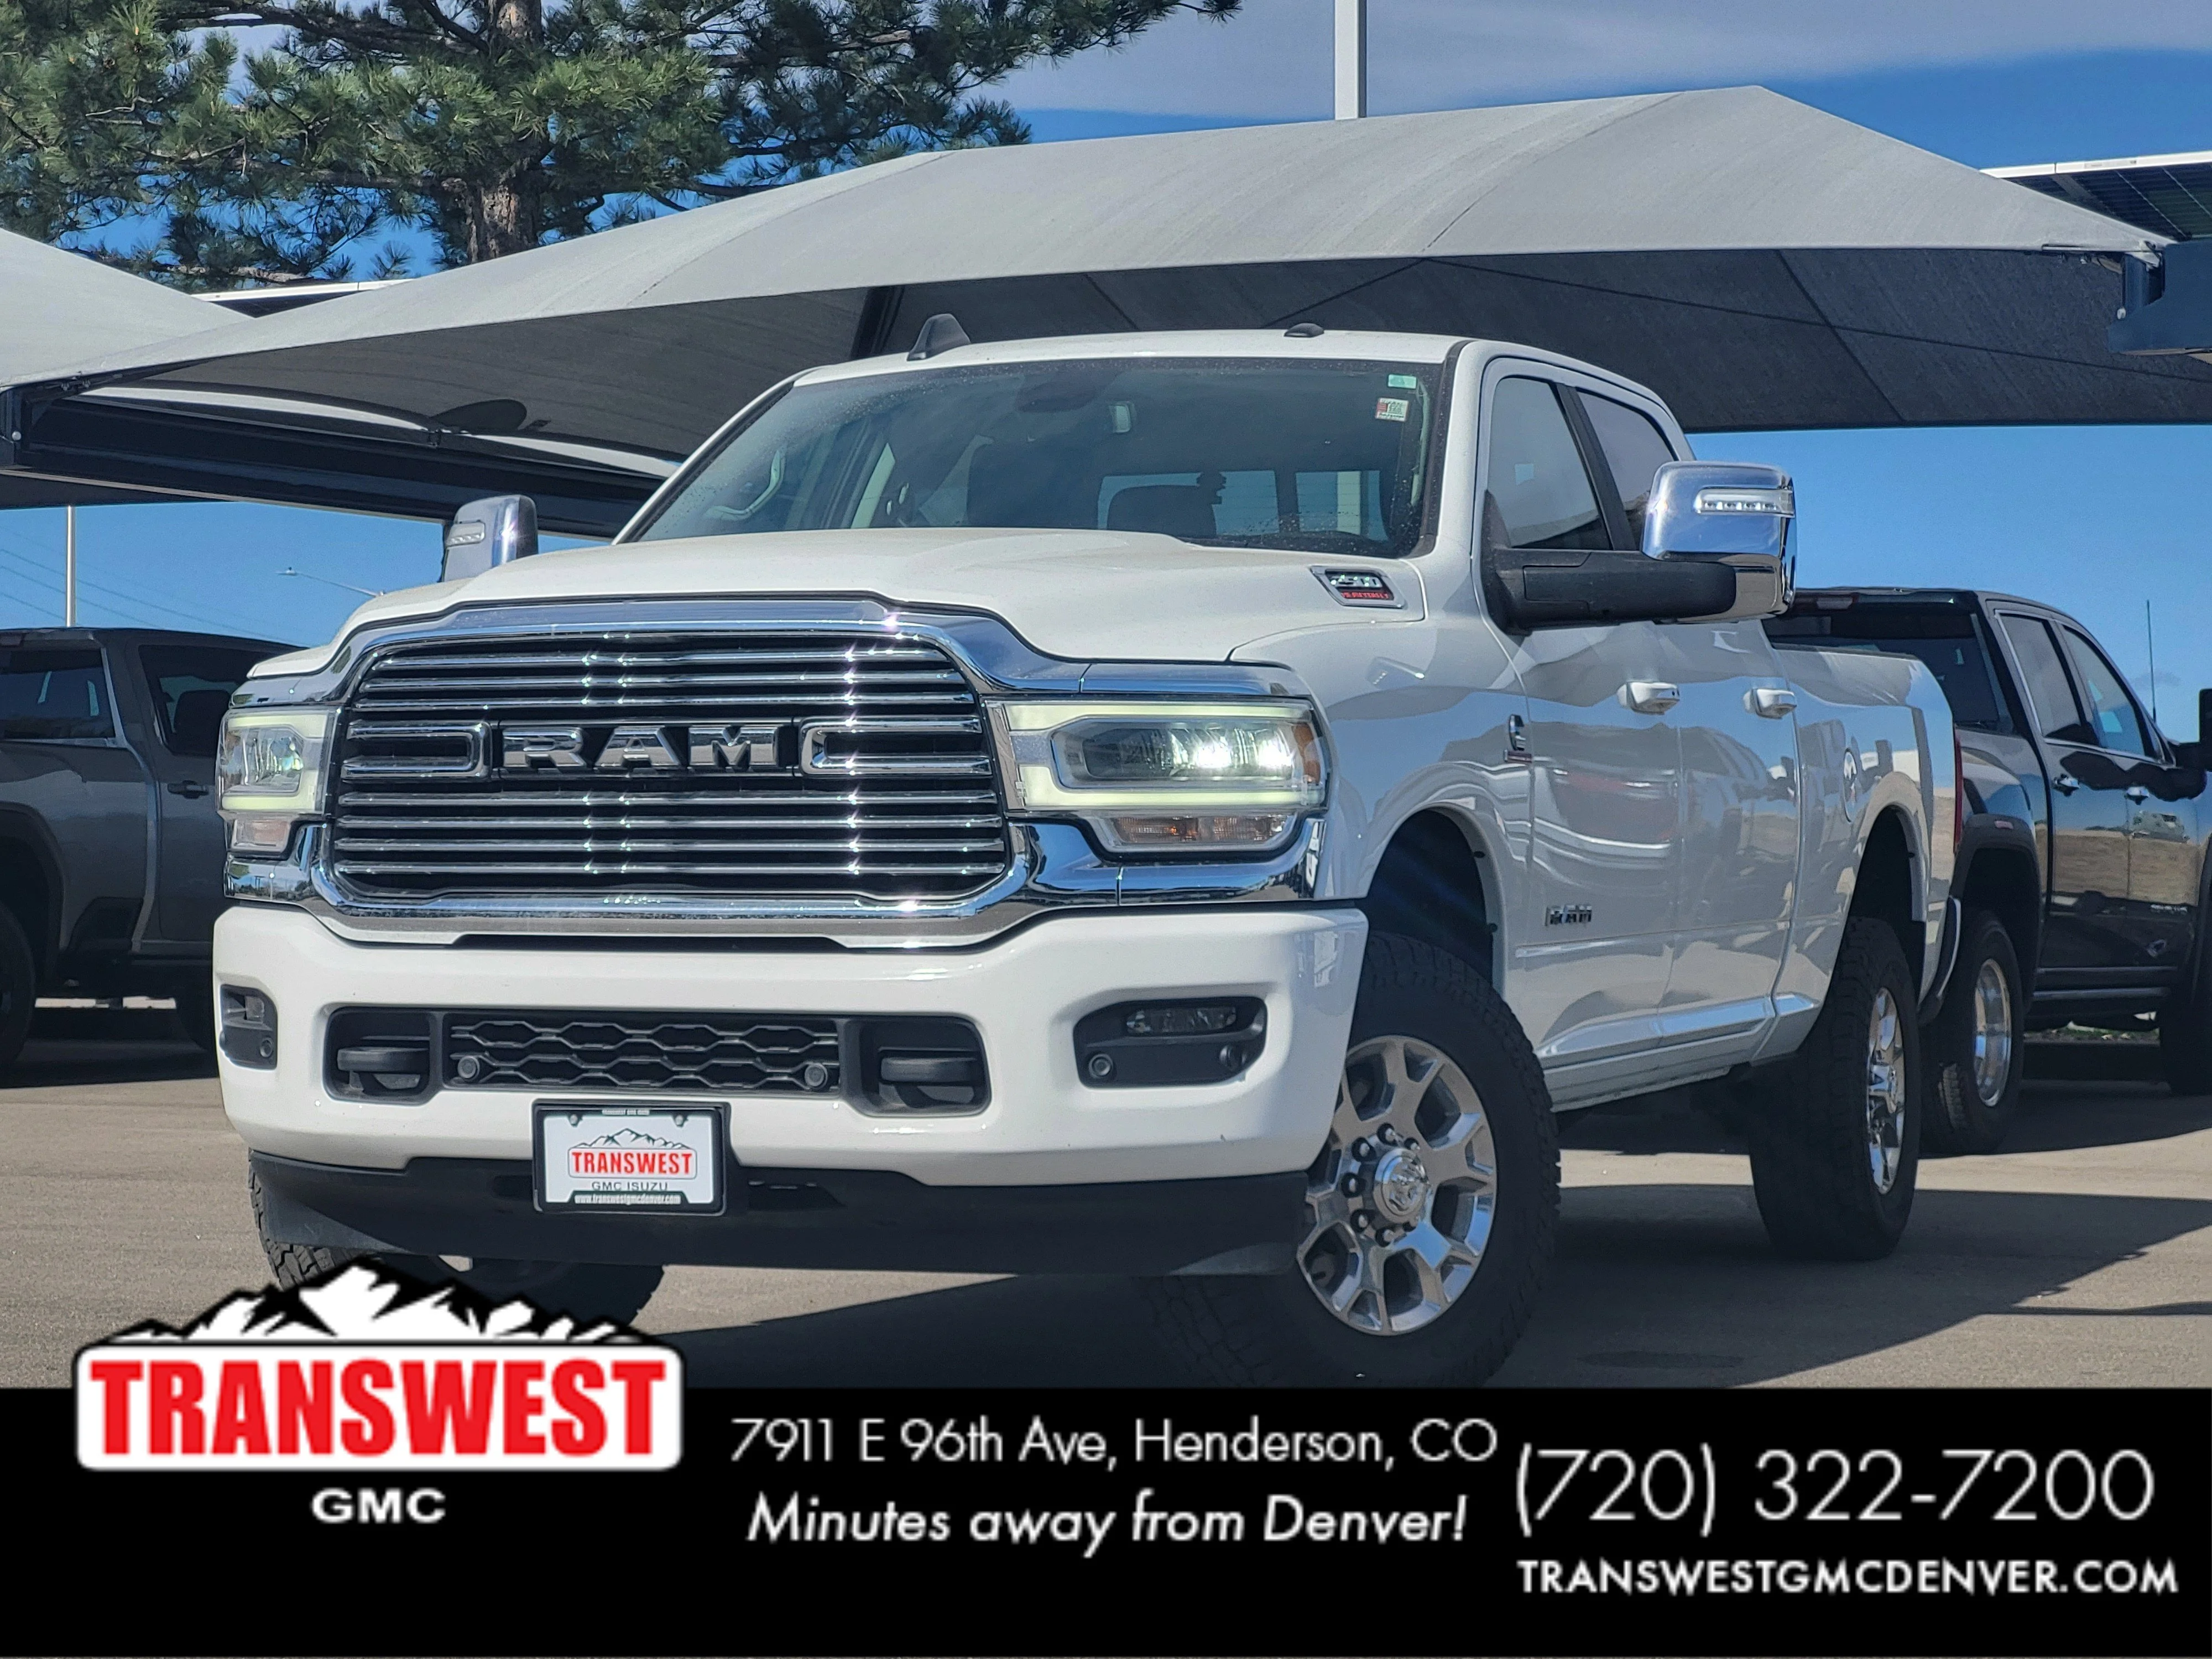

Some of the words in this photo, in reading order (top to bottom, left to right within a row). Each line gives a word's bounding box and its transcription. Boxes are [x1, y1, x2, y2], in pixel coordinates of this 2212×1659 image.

[502, 724, 778, 770] RAM
[572, 1152, 692, 1174] TRANSWEST
[592, 1181, 622, 1191] GMC
[628, 1182, 668, 1191] ISUZU
